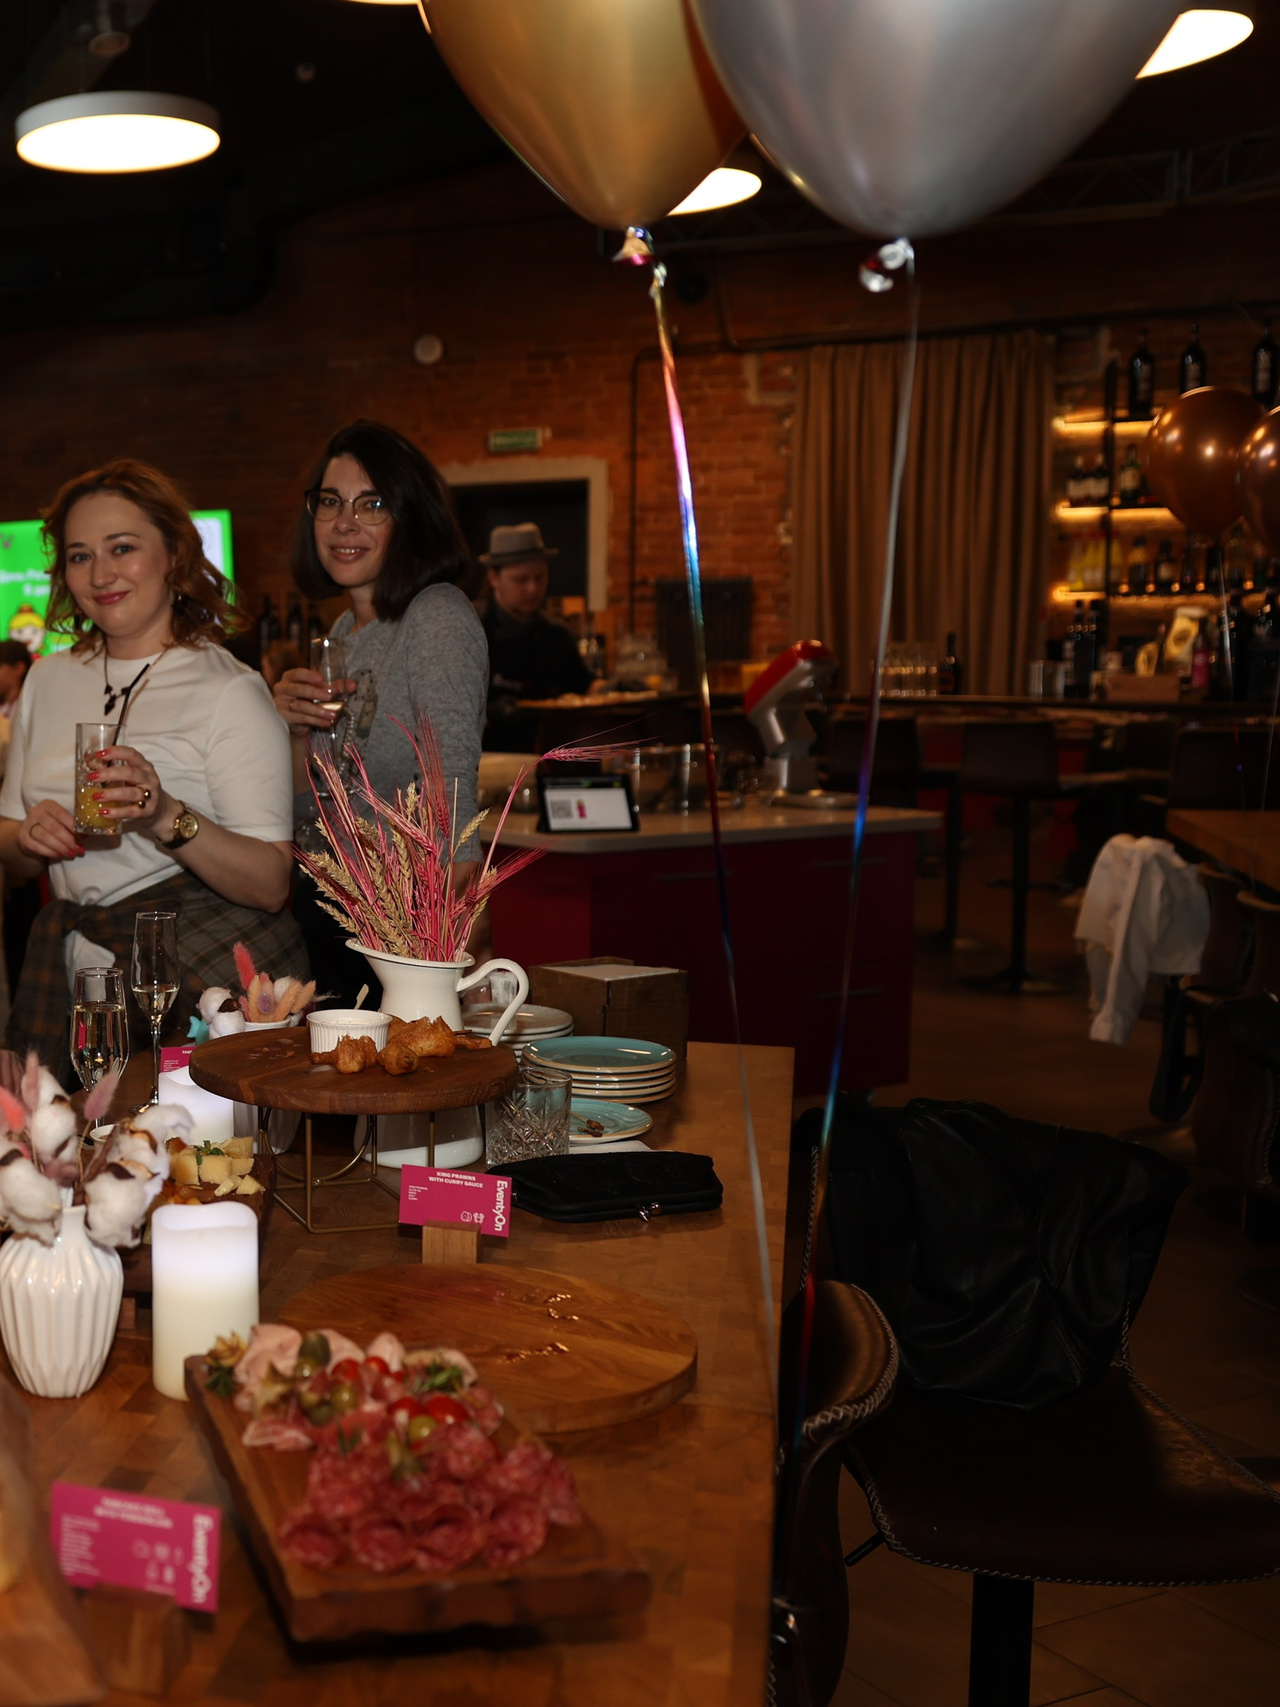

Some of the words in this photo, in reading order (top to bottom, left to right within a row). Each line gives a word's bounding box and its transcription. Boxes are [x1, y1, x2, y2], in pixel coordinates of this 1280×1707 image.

[451, 1173, 477, 1181] PRAWNS
[444, 1178, 464, 1186] CURRY
[464, 1180, 484, 1188] SAUCE
[492, 1180, 508, 1231] EventyOn
